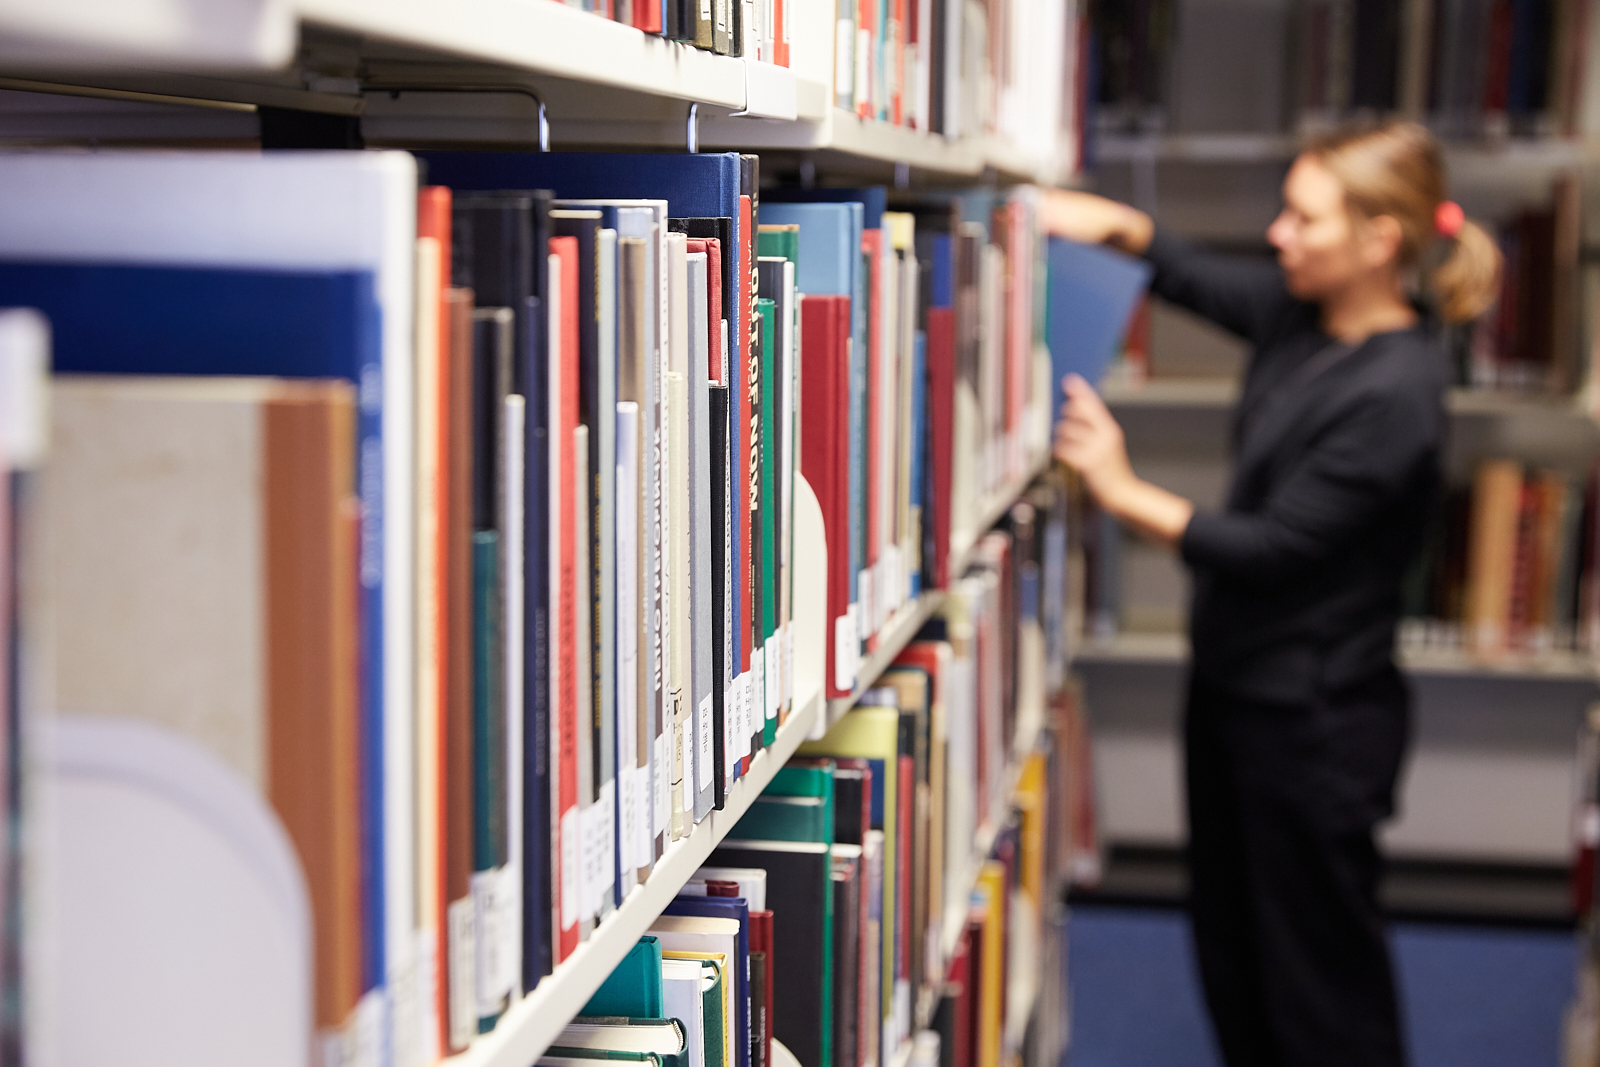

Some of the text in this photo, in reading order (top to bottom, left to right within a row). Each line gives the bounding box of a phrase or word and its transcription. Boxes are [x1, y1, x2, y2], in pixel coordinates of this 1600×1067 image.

[751, 266, 759, 346] OUT
[750, 355, 759, 405] OF
[750, 413, 758, 510] NOW
